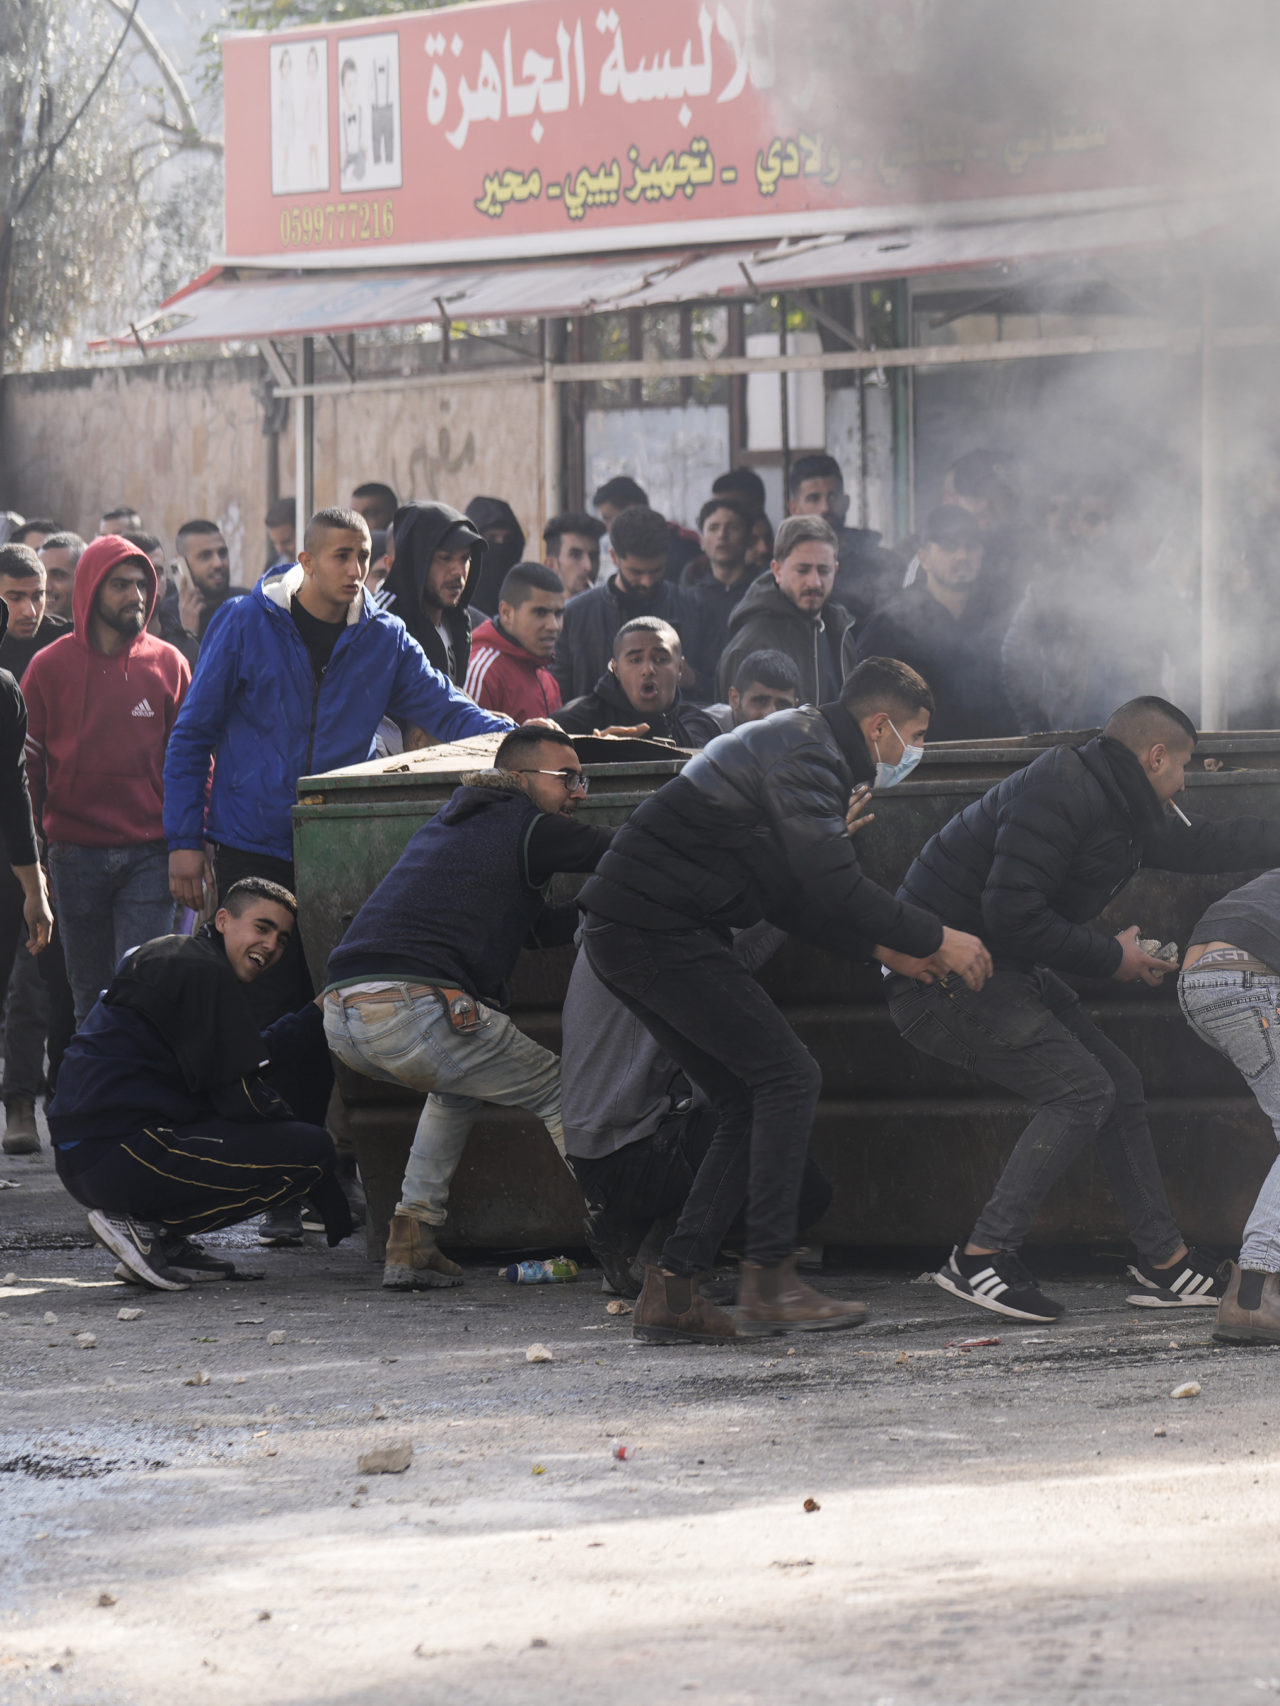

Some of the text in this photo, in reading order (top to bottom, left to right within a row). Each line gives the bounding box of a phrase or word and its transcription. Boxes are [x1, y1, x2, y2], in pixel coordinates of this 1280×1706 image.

[422, 16, 587, 150] الجاهزة
[474, 167, 542, 219] محير
[563, 157, 621, 221] بيبي
[623, 136, 714, 204] تجهيز
[280, 198, 395, 248] 0599777216
